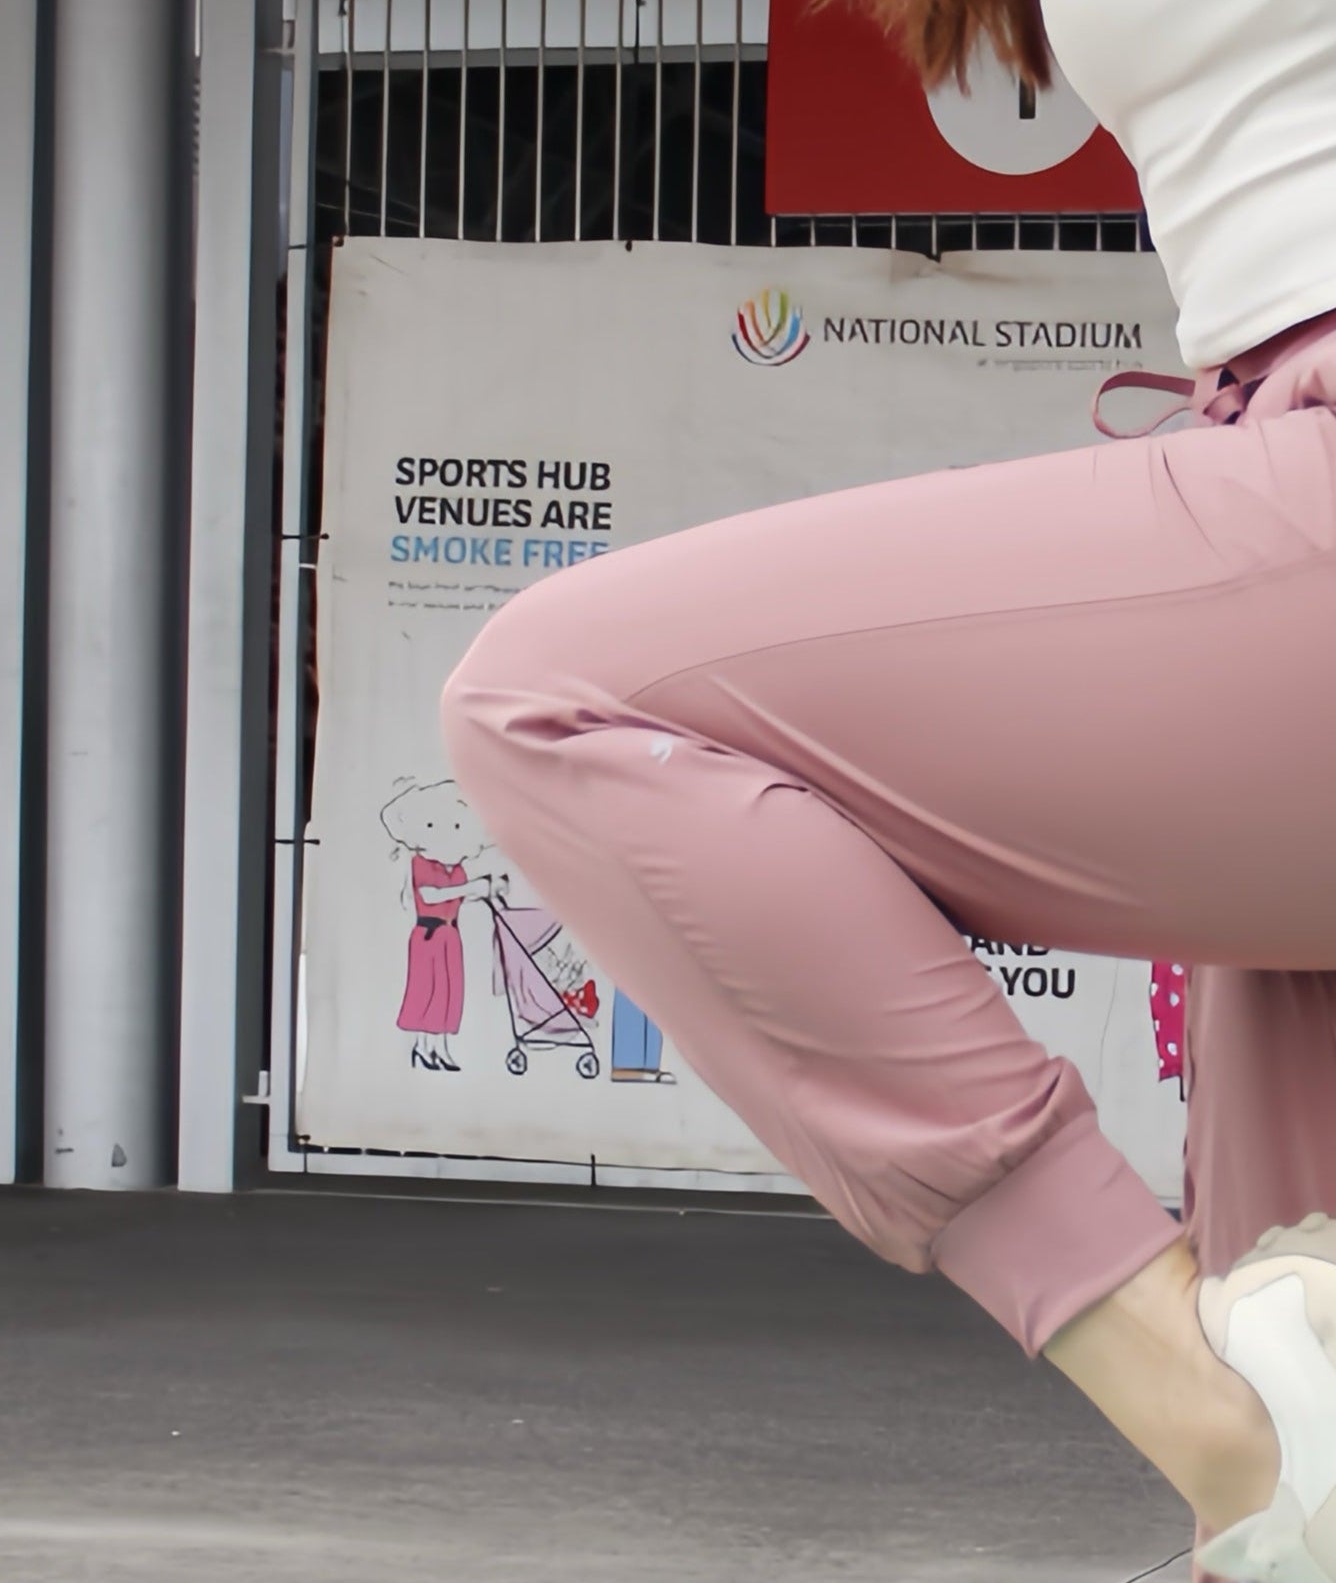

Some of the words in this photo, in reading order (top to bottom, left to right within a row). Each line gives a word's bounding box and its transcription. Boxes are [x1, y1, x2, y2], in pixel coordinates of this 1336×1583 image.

[823, 316, 986, 347] NATIONAL
[996, 320, 1143, 349] STADIUM
[395, 457, 527, 487] SPORTS
[537, 460, 611, 491] HUB
[394, 495, 532, 527] VENUES
[540, 500, 612, 530] ARE
[390, 535, 512, 566] SMOKE
[1000, 967, 1075, 999] YOU
